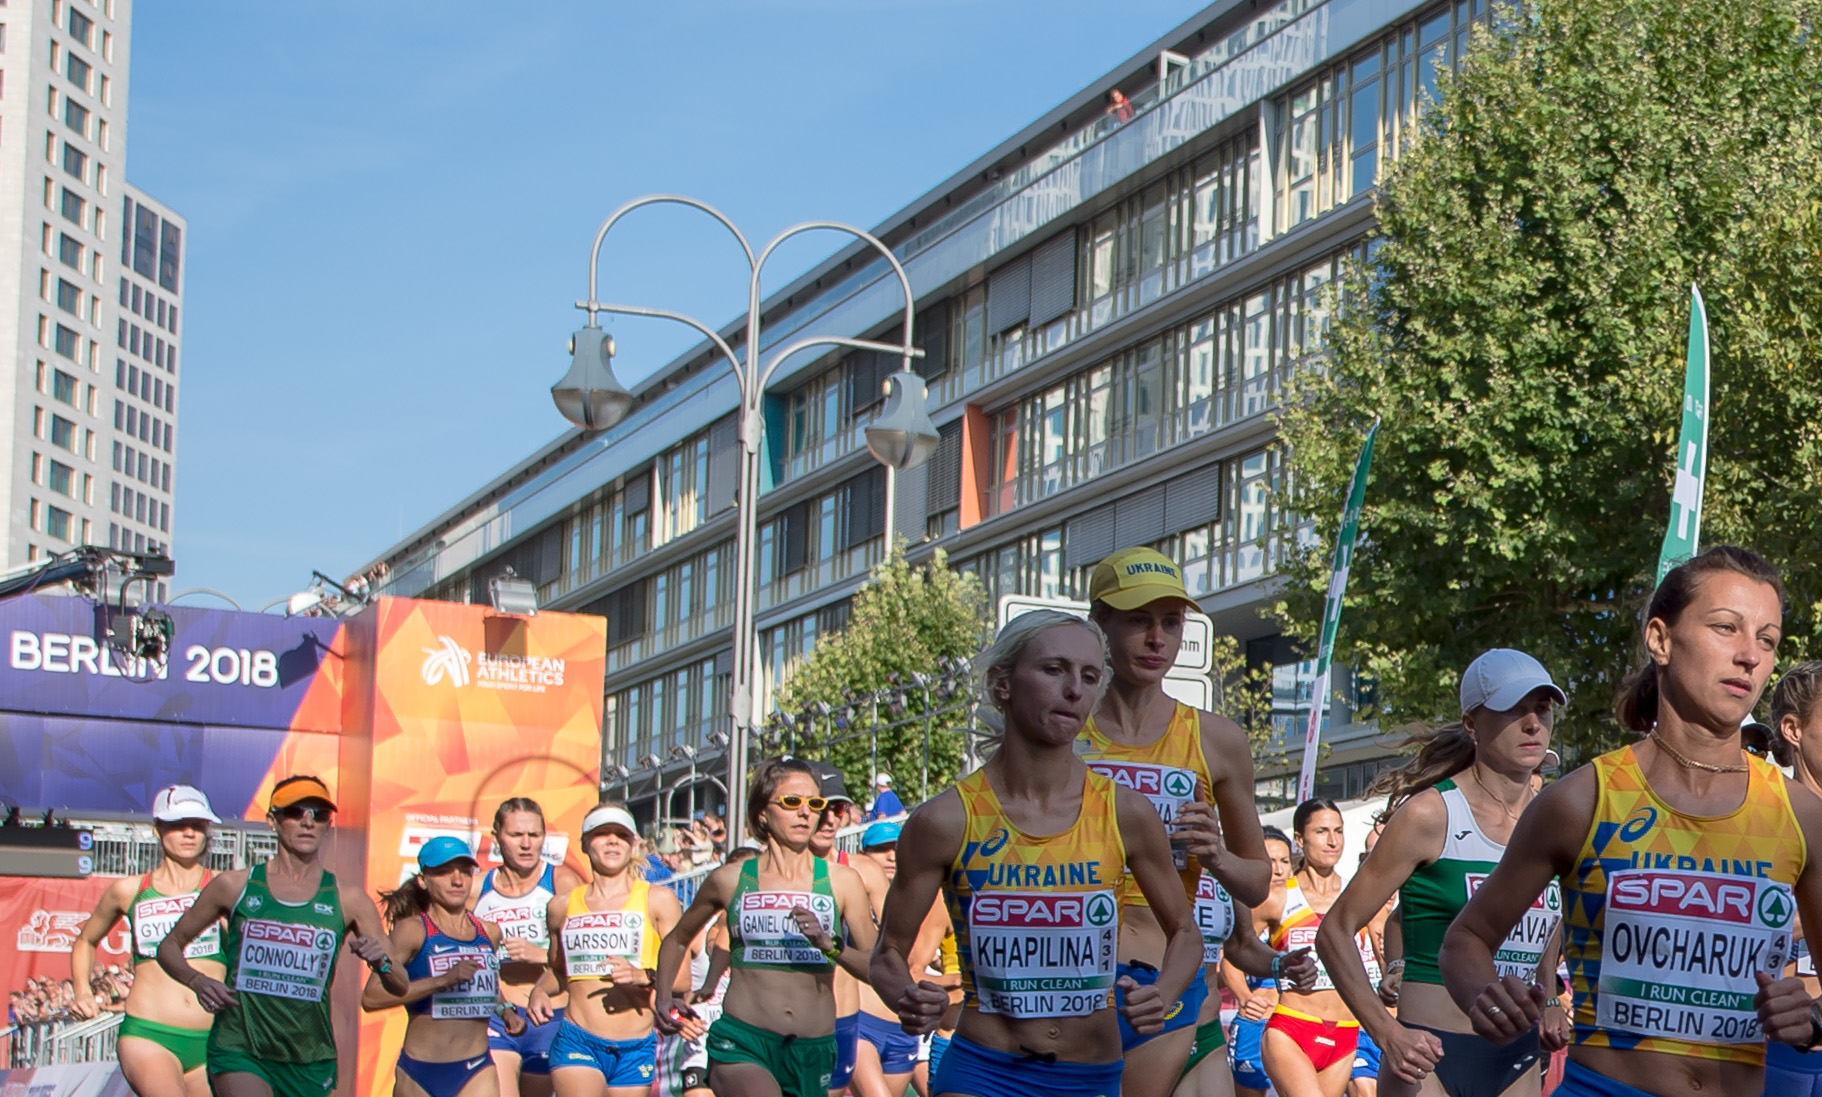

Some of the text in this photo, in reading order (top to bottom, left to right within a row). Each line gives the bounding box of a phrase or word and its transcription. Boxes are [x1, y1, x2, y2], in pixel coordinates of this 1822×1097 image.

[1126, 562, 1178, 579] UKRAINE
[186, 645, 279, 687] 2018
[478, 651, 565, 673] EUROPEAN
[477, 666, 564, 686] ATHLETICS
[987, 861, 1102, 887] UKRAINE
[745, 894, 808, 909] SPAR
[1616, 878, 1751, 917] SPAR
[975, 898, 1081, 923] SPAR
[568, 914, 622, 928] SPAR
[744, 915, 780, 933] GANIEL
[248, 923, 312, 946] SPAR
[566, 933, 628, 950] LARSSON
[191, 944, 214, 956] 2018
[245, 944, 318, 972] CONNOLLY
[751, 949, 820, 961] BERLIN 2018
[977, 936, 1095, 968] KHAPILINA
[1101, 929, 1112, 971] 431
[1612, 923, 1766, 979] OVCHARUK
[245, 979, 317, 998] BERLIN 2018
[1010, 980, 1037, 990] RUN
[1640, 985, 1645, 997] I
[1650, 986, 1685, 1002] RUN
[441, 1007, 480, 1017] BERLIN
[990, 993, 1103, 1013] BERLIN 2018
[1613, 1001, 1759, 1038] BERLIN 2018
